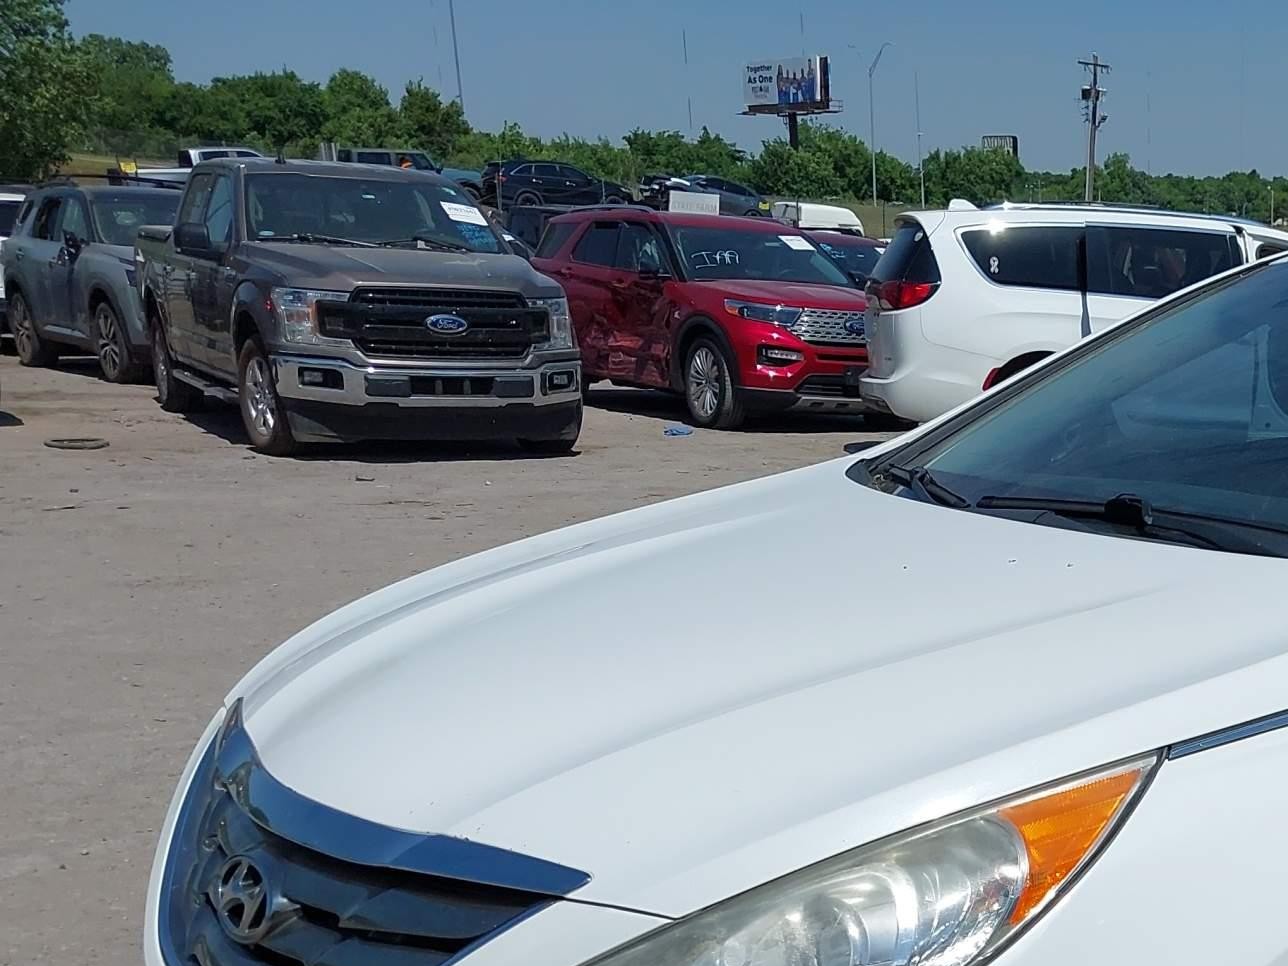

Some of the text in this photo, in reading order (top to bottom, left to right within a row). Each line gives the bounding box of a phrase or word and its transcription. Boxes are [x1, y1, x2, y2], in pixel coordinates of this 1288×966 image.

[746, 65, 772, 74] Together
[748, 75, 773, 83] As One
